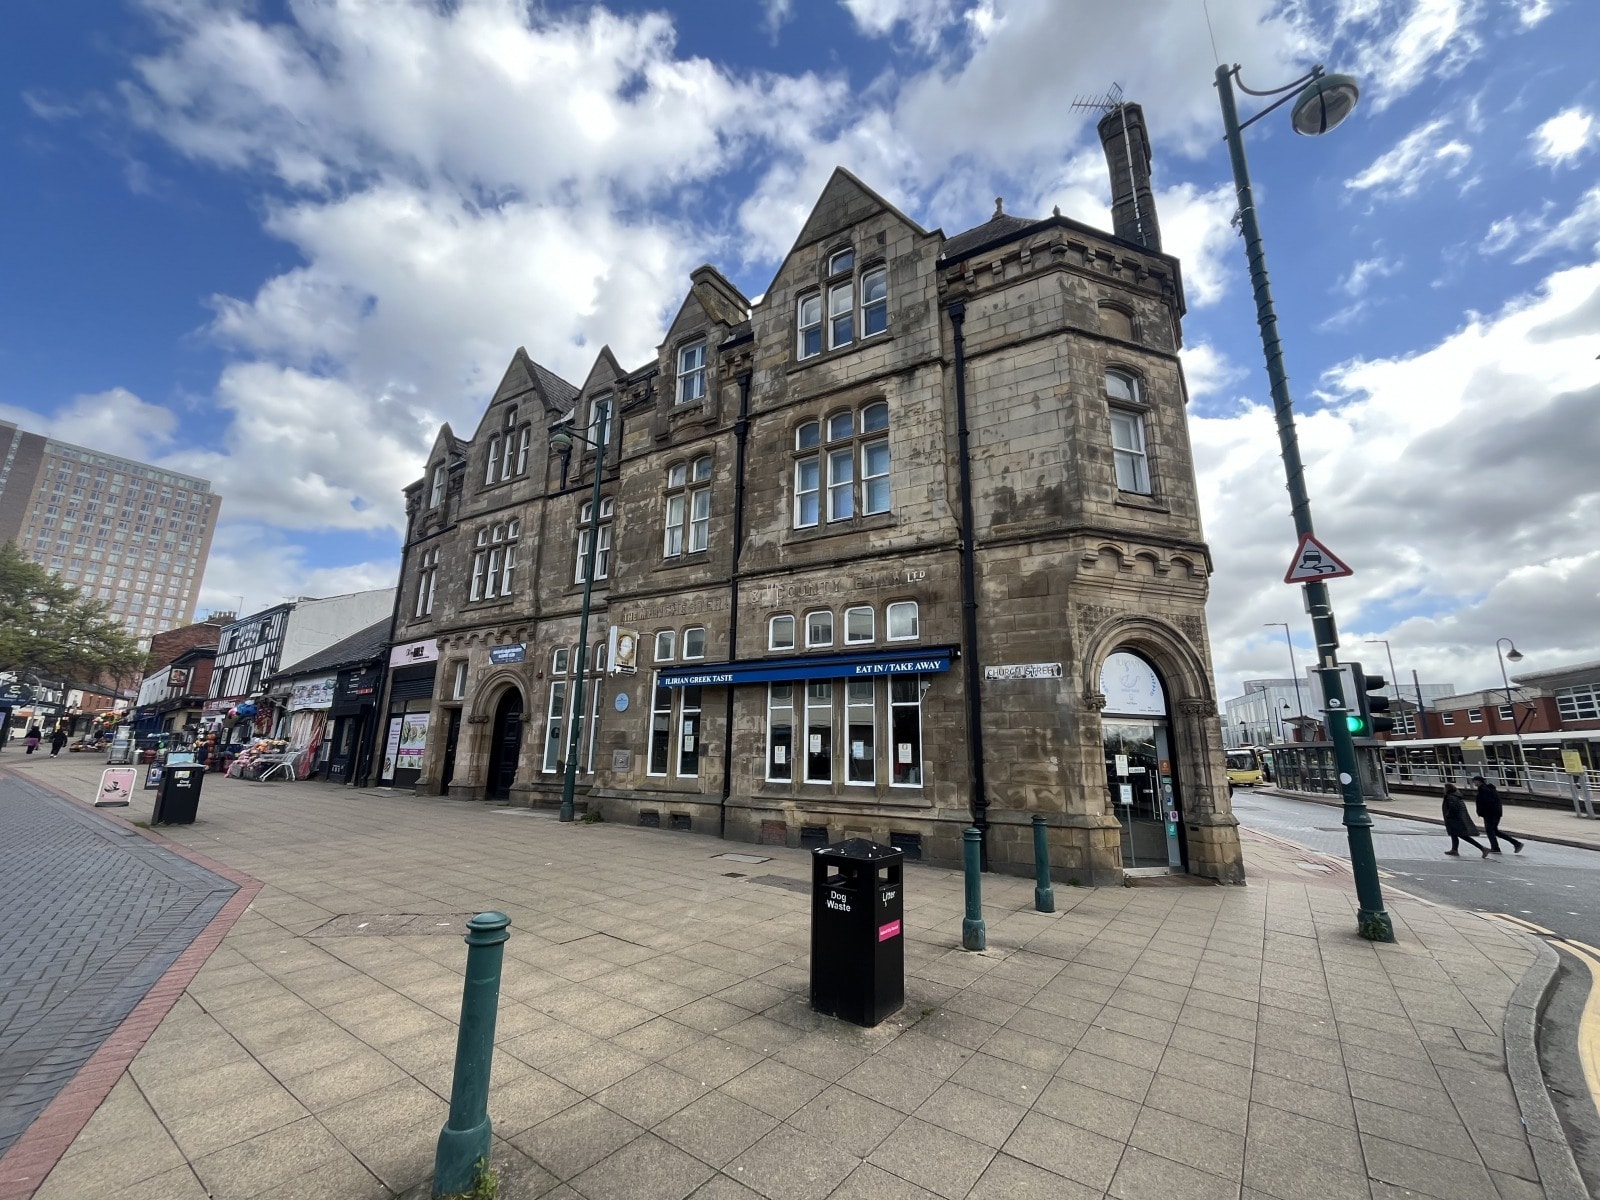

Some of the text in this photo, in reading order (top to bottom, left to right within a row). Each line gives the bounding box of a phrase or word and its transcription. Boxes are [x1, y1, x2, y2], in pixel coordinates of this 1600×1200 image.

[776, 579, 843, 600] COUNTY
[907, 570, 926, 583] LTD
[624, 612, 637, 622] THE
[855, 665, 873, 674] EAT
[873, 664, 884, 673] IN
[889, 662, 914, 672] TAKE
[914, 660, 941, 670] AWAY
[1025, 665, 1059, 675] STREE
[665, 674, 733, 685] ILIRIAN GREEK TASTE
[830, 890, 847, 903] Dog
[826, 899, 851, 912] Waste
